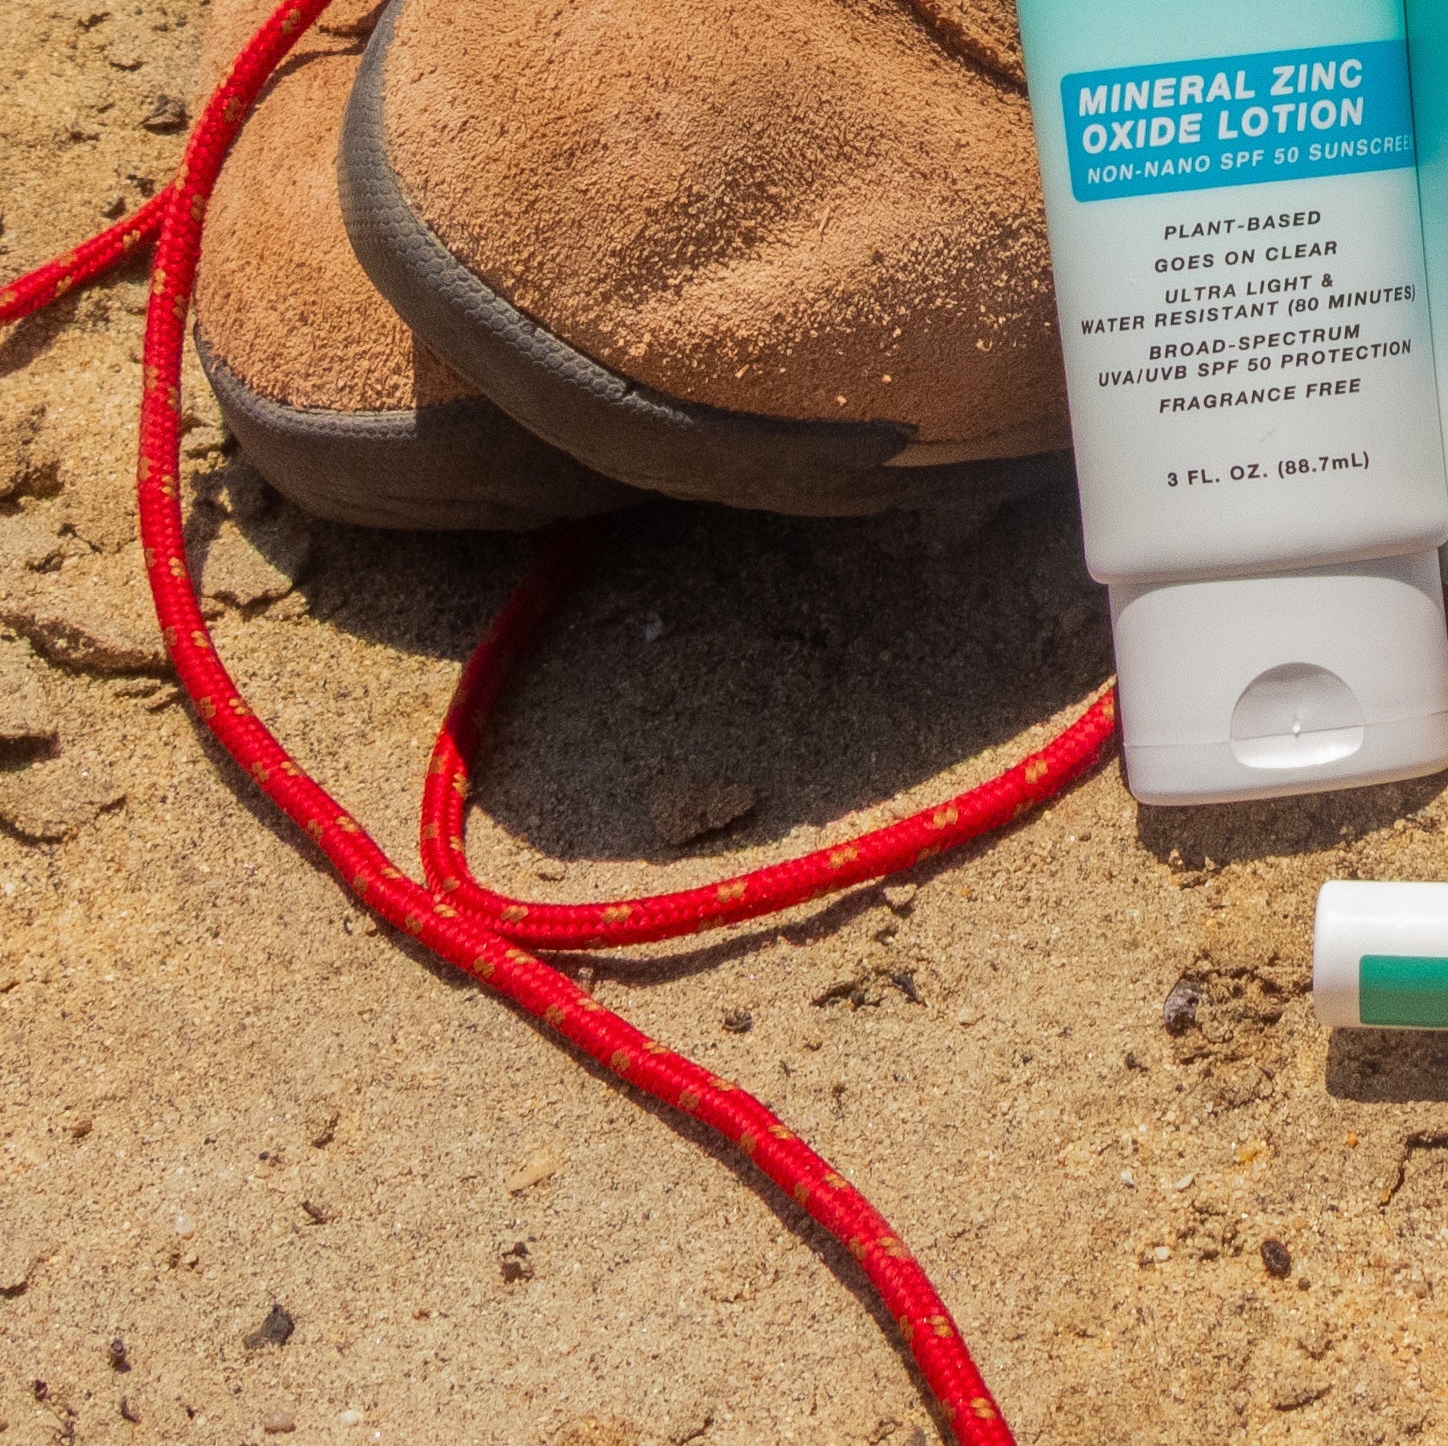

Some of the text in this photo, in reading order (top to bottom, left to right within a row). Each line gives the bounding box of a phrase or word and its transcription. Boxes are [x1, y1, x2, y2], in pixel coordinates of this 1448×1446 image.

[1078, 58, 1363, 116] MINERAL ZINC
[1082, 97, 1364, 154] OXIDE LOTION
[1087, 155, 1211, 184] NON-NANO
[1220, 149, 1264, 170] SPF
[1274, 146, 1299, 165] 50
[1164, 210, 1322, 240] PLANT-BASED
[1154, 241, 1338, 273] GOES ON CLEAR
[1165, 273, 1333, 304] ULTRA LIGHT &
[1081, 285, 1416, 334] WATER RESISTANT (80 MINUTES)
[1149, 324, 1361, 360] BROAD-SPECTRUM
[1099, 339, 1412, 387] UVA/UVB SPF 50 PROTECTION
[1159, 378, 1362, 414] FRAGRANCE FREE
[1167, 451, 1370, 487] 3 FL. OZ. (88.7mL)
